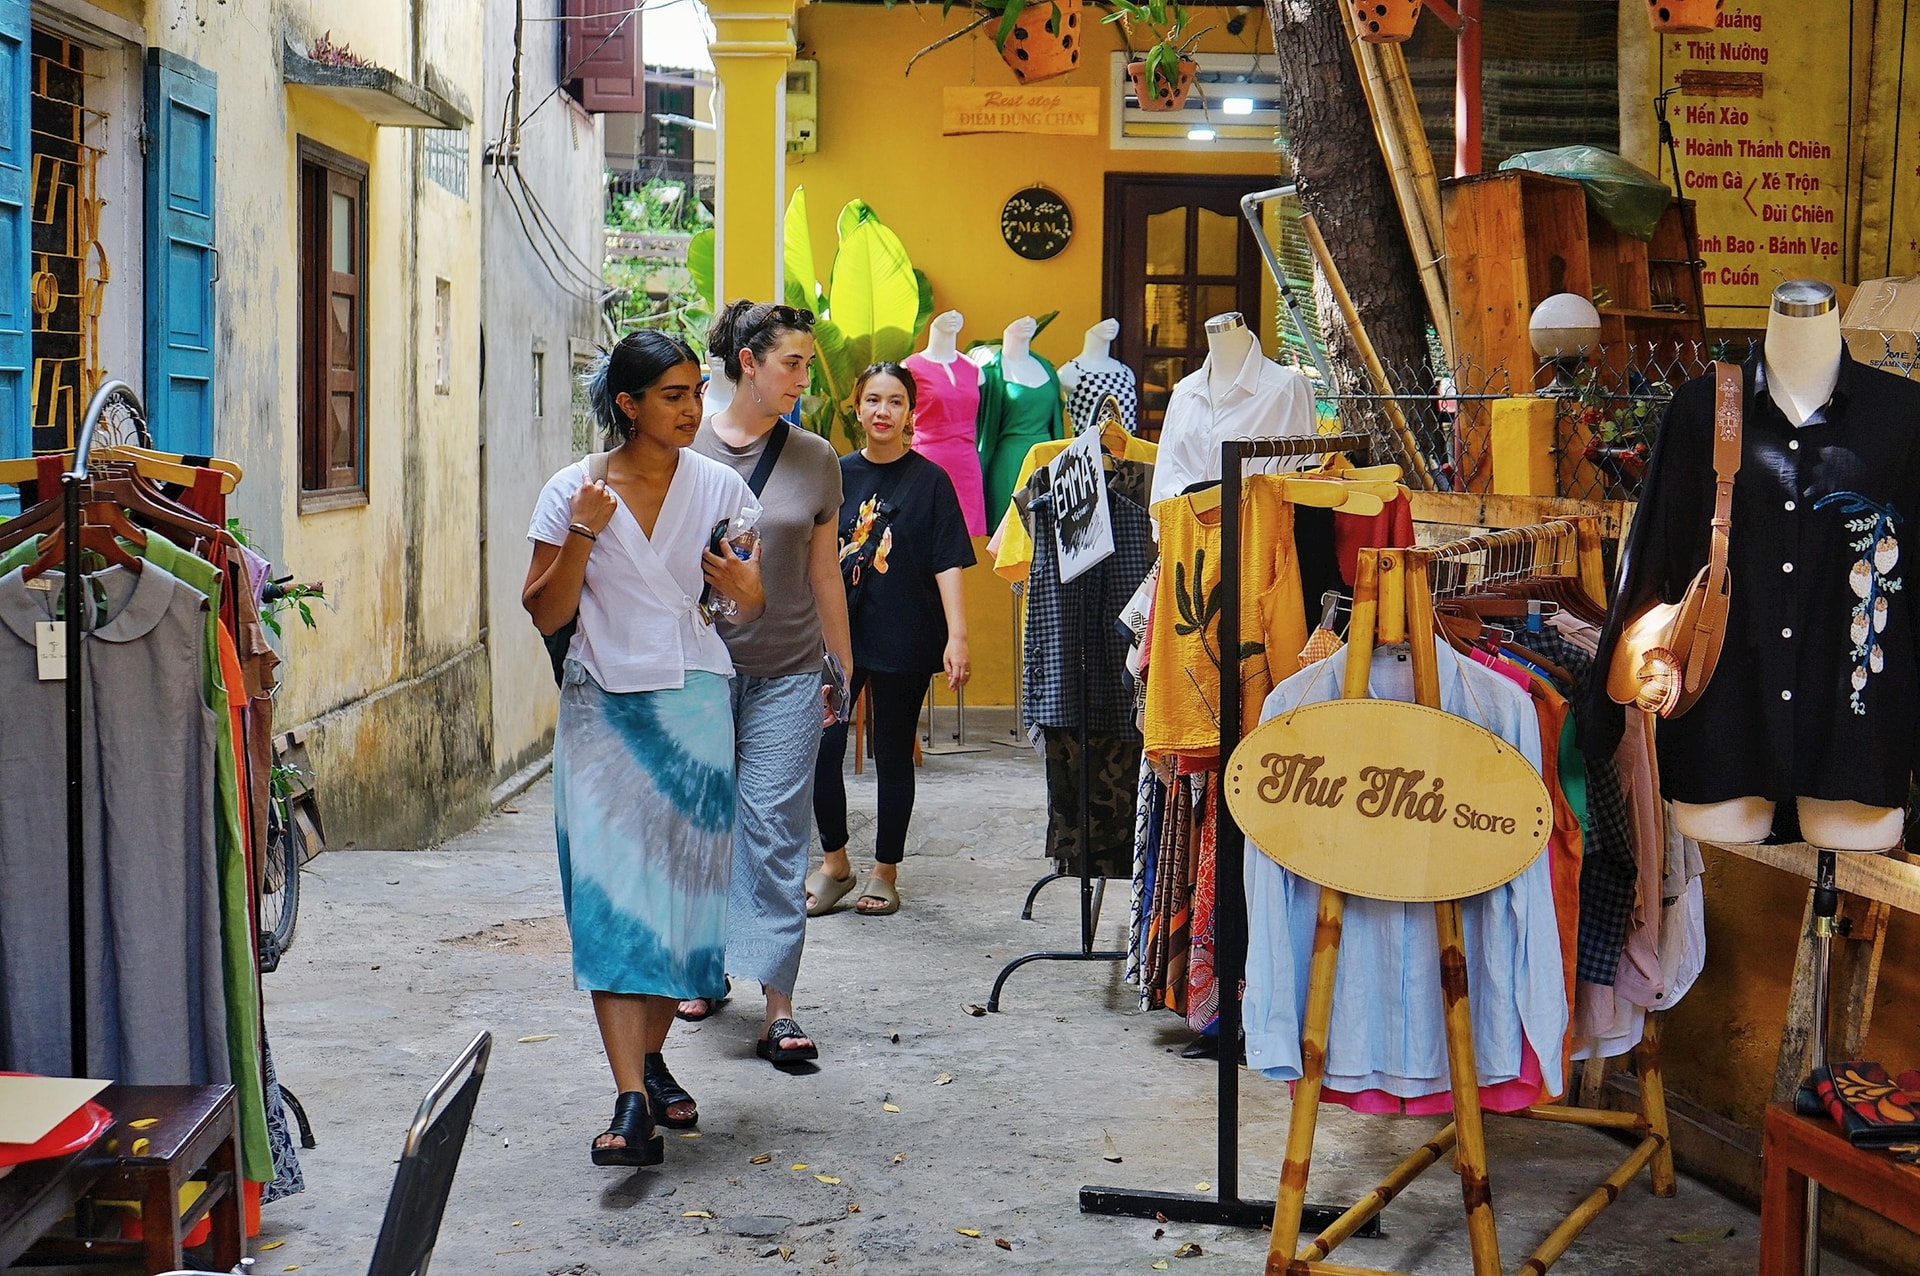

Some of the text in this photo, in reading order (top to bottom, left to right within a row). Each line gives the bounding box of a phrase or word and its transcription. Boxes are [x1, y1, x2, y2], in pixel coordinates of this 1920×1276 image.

[1687, 40, 1769, 65] Thịt Nướng
[984, 91, 1062, 109] Rest stop
[1686, 103, 1749, 126] Hến Xào
[1686, 138, 1831, 160] Hoành Thánh Chiên
[1685, 170, 1820, 196] Cơm Gà Xé Trộn
[1762, 203, 1834, 223] Đùi Chiên
[1726, 235, 1755, 254] Bao
[1768, 236, 1807, 255] Bánh
[1811, 237, 1839, 260] Vạc
[1721, 264, 1759, 286] Cuốn
[1054, 454, 1095, 520] EMMA
[1257, 753, 1516, 835] Thư Thả Store
